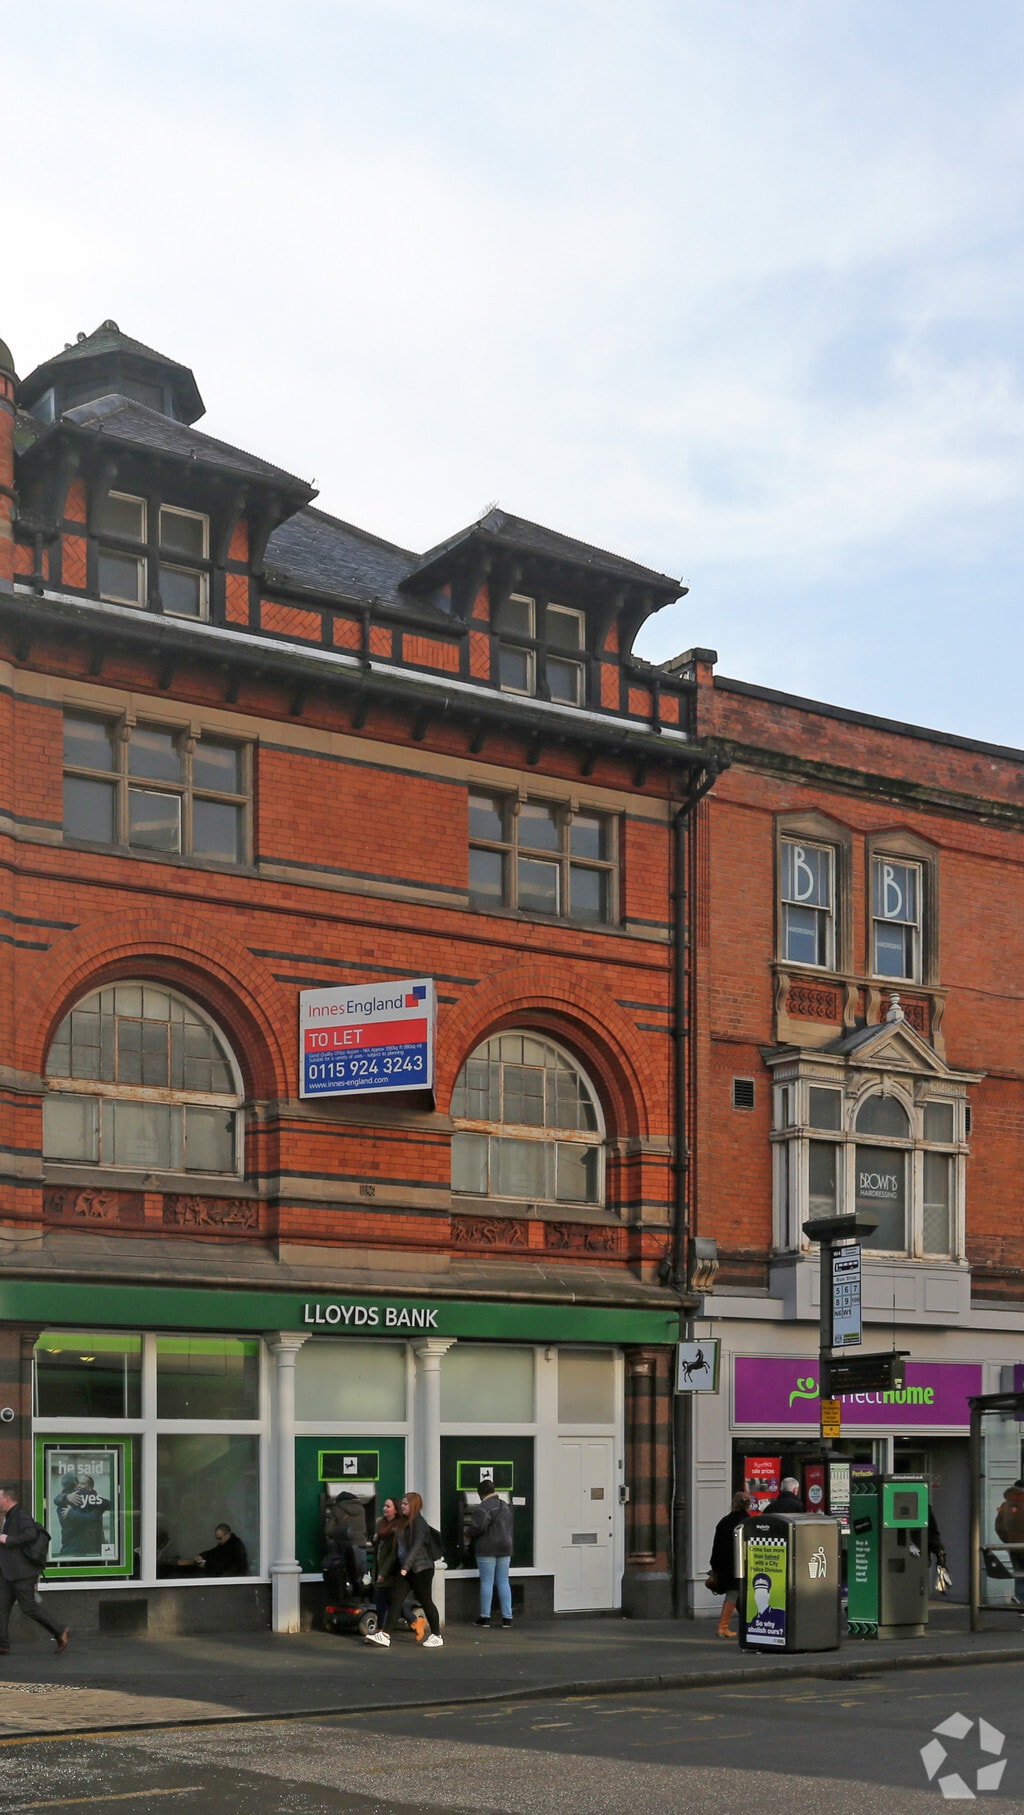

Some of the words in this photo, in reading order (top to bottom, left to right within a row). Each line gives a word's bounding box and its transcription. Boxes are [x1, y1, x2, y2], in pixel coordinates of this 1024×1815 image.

[794, 846, 813, 900] B
[883, 865, 902, 918] B
[308, 1004, 345, 1018] Innes
[347, 994, 403, 1016] England
[309, 1032, 329, 1048] TO
[333, 1029, 363, 1046] LET
[308, 1062, 345, 1080] 0115
[349, 1059, 379, 1076] 924
[382, 1055, 423, 1074] 3243
[308, 1076, 389, 1089] www.innes-england.com
[835, 1287, 840, 1295] 5
[844, 1285, 849, 1294] 6
[853, 1284, 858, 1292] 7
[844, 1297, 849, 1305] 9
[304, 1303, 379, 1326] LLOYDS
[385, 1307, 439, 1328] BANK
[58, 1460, 76, 1474] he
[77, 1460, 104, 1475] said
[80, 1494, 103, 1509] yes
[747, 1626, 767, 1634] abolish
[755, 1619, 764, 1627] So
[763, 1620, 775, 1629] why
